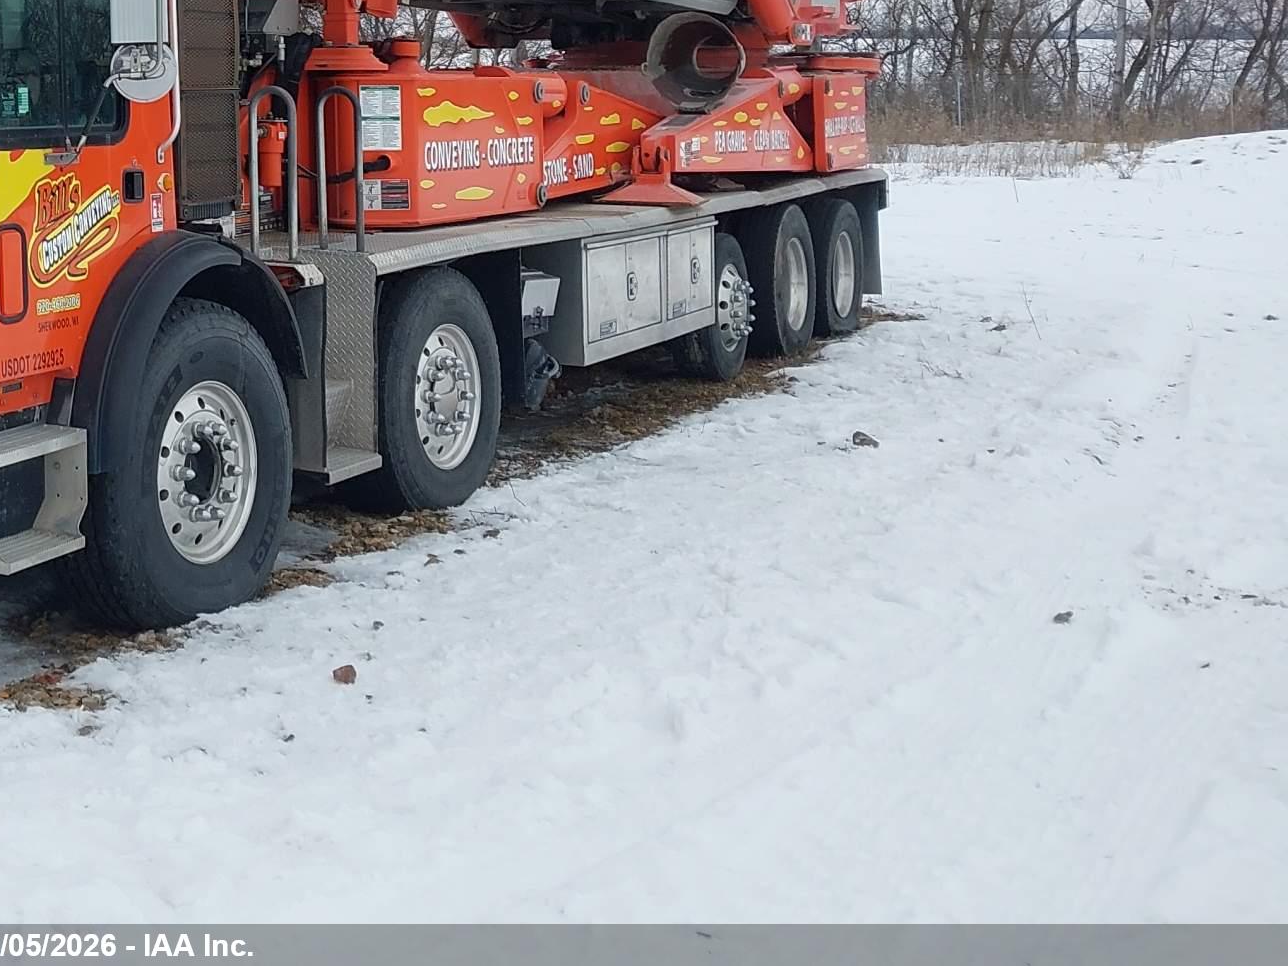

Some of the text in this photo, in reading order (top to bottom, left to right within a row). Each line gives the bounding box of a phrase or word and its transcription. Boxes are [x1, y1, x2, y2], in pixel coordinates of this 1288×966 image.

[424, 138, 480, 171] CONVEYING
[487, 136, 534, 166] CONCRETE
[715, 130, 726, 153] PEA
[543, 158, 567, 185] STONE
[573, 153, 595, 180] SAND
[35, 175, 79, 232] Bill's
[42, 224, 73, 272] CUSTOM
[73, 188, 112, 246] CONVEYING
[1, 355, 30, 378] USDOT
